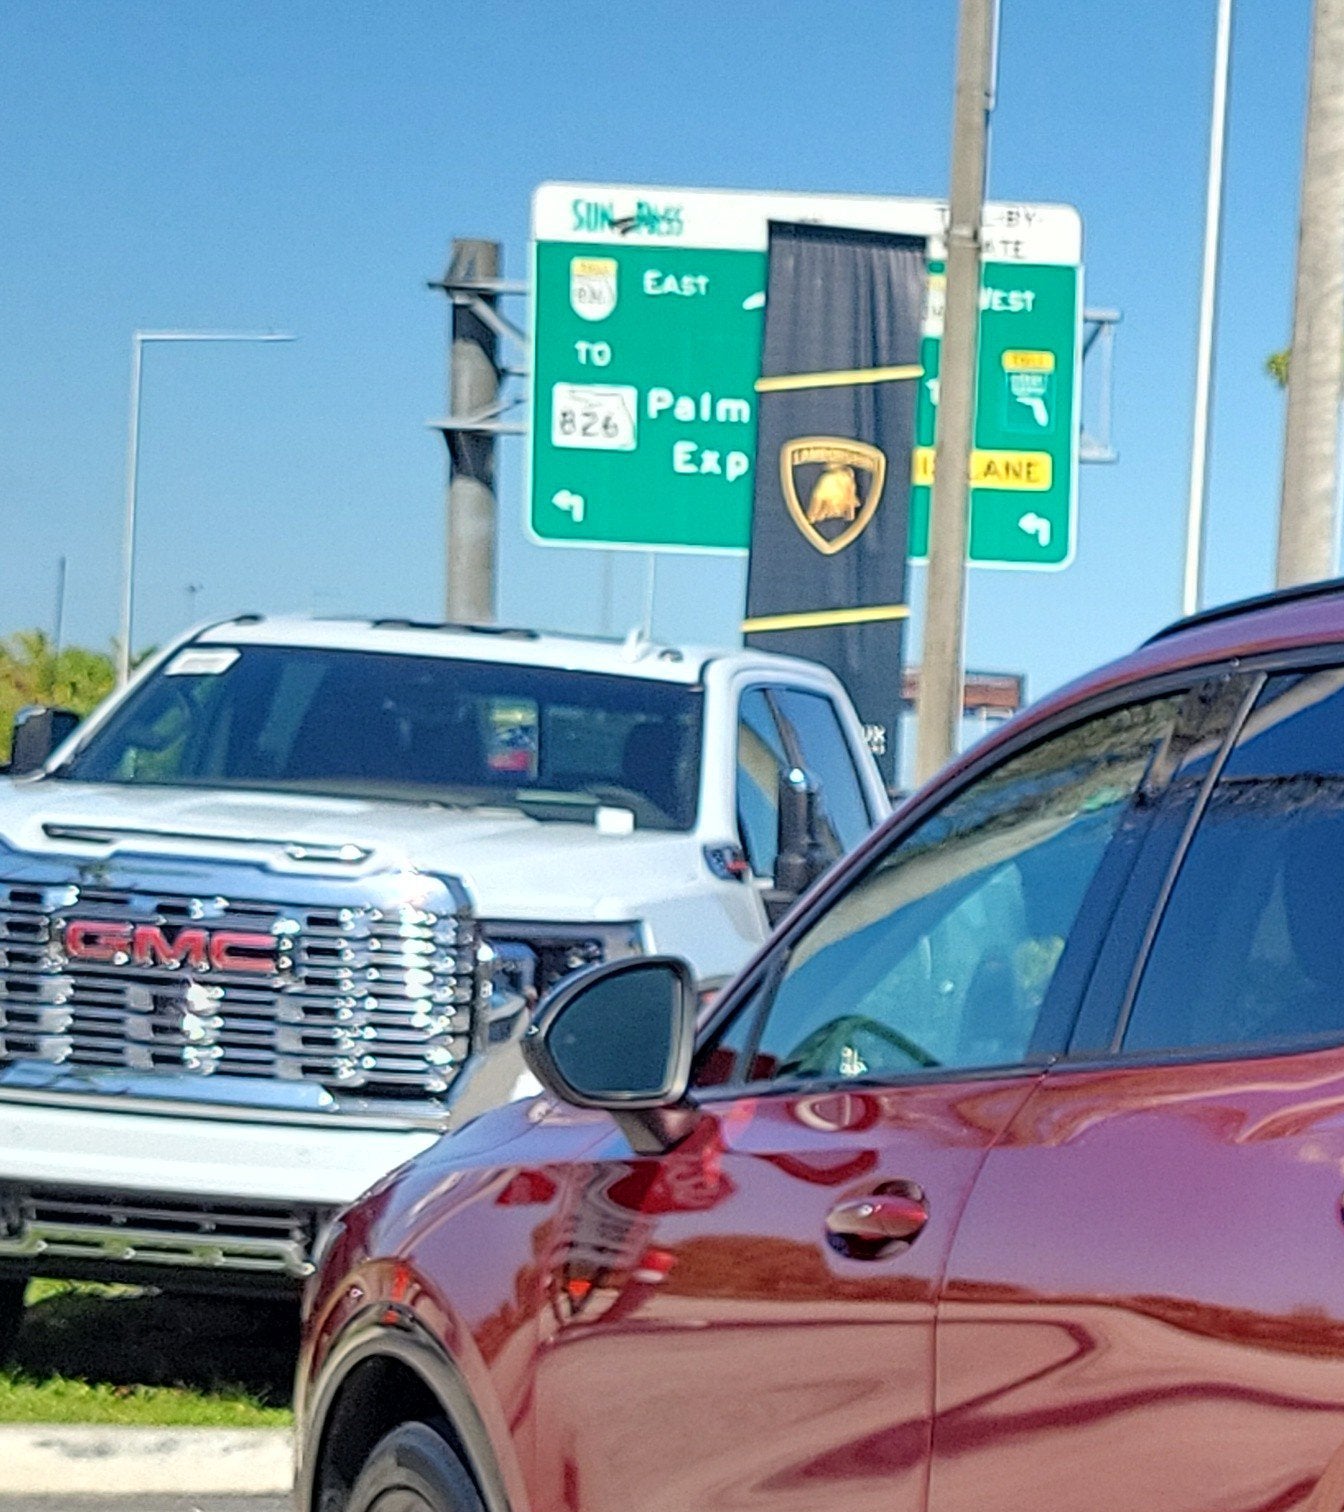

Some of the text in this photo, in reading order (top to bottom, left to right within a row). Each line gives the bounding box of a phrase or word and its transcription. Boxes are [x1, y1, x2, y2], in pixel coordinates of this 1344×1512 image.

[643, 268, 710, 297] EAST
[574, 340, 612, 367] TO
[559, 410, 619, 438] 826
[65, 919, 279, 974] GMC
